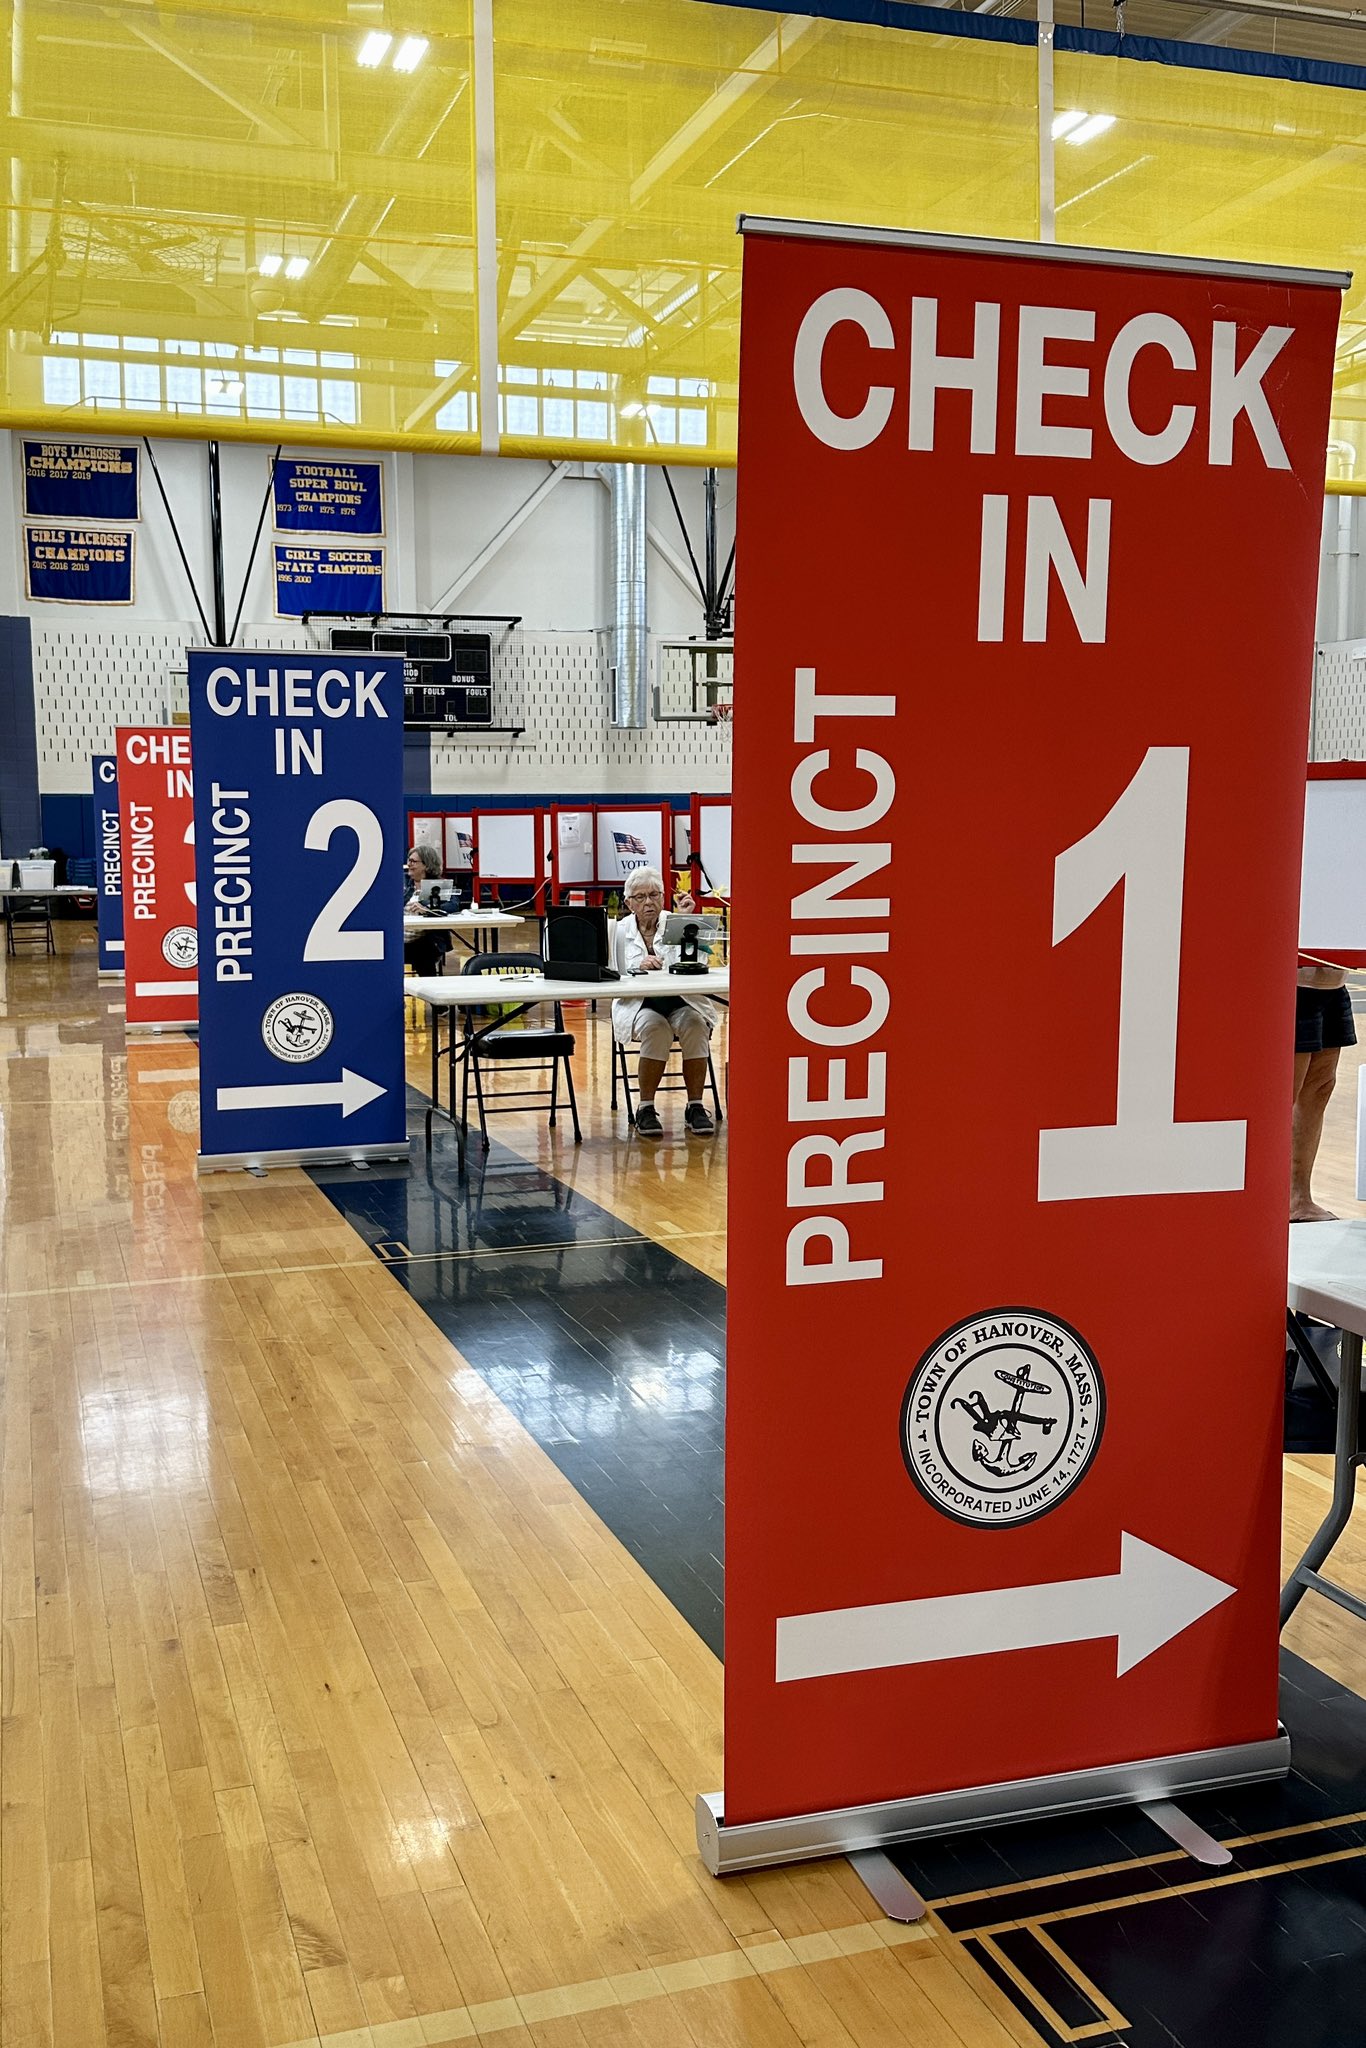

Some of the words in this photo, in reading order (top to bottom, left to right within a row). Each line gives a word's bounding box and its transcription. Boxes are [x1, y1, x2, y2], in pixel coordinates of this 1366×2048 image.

[793, 287, 1296, 470] CHECK
[30, 456, 132, 473] CHAMPIONS
[41, 445, 67, 457] BOYS
[71, 446, 121, 460] LACROSSE
[26, 468, 46, 477] 2016
[49, 470, 69, 479] 2017
[289, 478, 328, 489] SUPER
[334, 480, 367, 492] BOWL
[295, 465, 357, 479] FOOTBALL
[295, 491, 362, 505] CHAMPIONS
[31, 530, 65, 544] GIRLS
[70, 532, 127, 547] LACROSSE
[35, 546, 125, 562] CHAMPIONS
[276, 561, 315, 573] STATE
[318, 564, 382, 575] CHAMPIONS
[285, 550, 320, 561] GIRLS
[328, 551, 372, 562] SOCCER
[977, 494, 1112, 643] IN
[206, 667, 388, 719] CHECK
[423, 687, 445, 695] FOULS
[451, 675, 475, 683] BONUS
[466, 688, 488, 696] FOULS
[126, 735, 191, 765] CHE
[275, 728, 323, 775] IN
[167, 769, 194, 798] IN
[101, 809, 122, 896] PRECINCT
[129, 801, 157, 920] PRECINCT
[211, 782, 253, 982] PRECINCT
[303, 798, 384, 962] 2
[786, 667, 896, 1286] PRECINCT
[1037, 746, 1247, 1202] 1
[265, 1008, 276, 1028] TOWN
[275, 1001, 284, 1009] OF
[916, 1362, 946, 1423] TOWN
[944, 1338, 968, 1363] OF
[972, 1322, 1064, 1358] HANOVER,
[1065, 1353, 1093, 1412] MASS.
[918, 1449, 1012, 1513] INCORPORATED
[1015, 1484, 1052, 1511] JUNE
[1052, 1469, 1071, 1486] 14,
[1067, 1434, 1086, 1466] 1727
